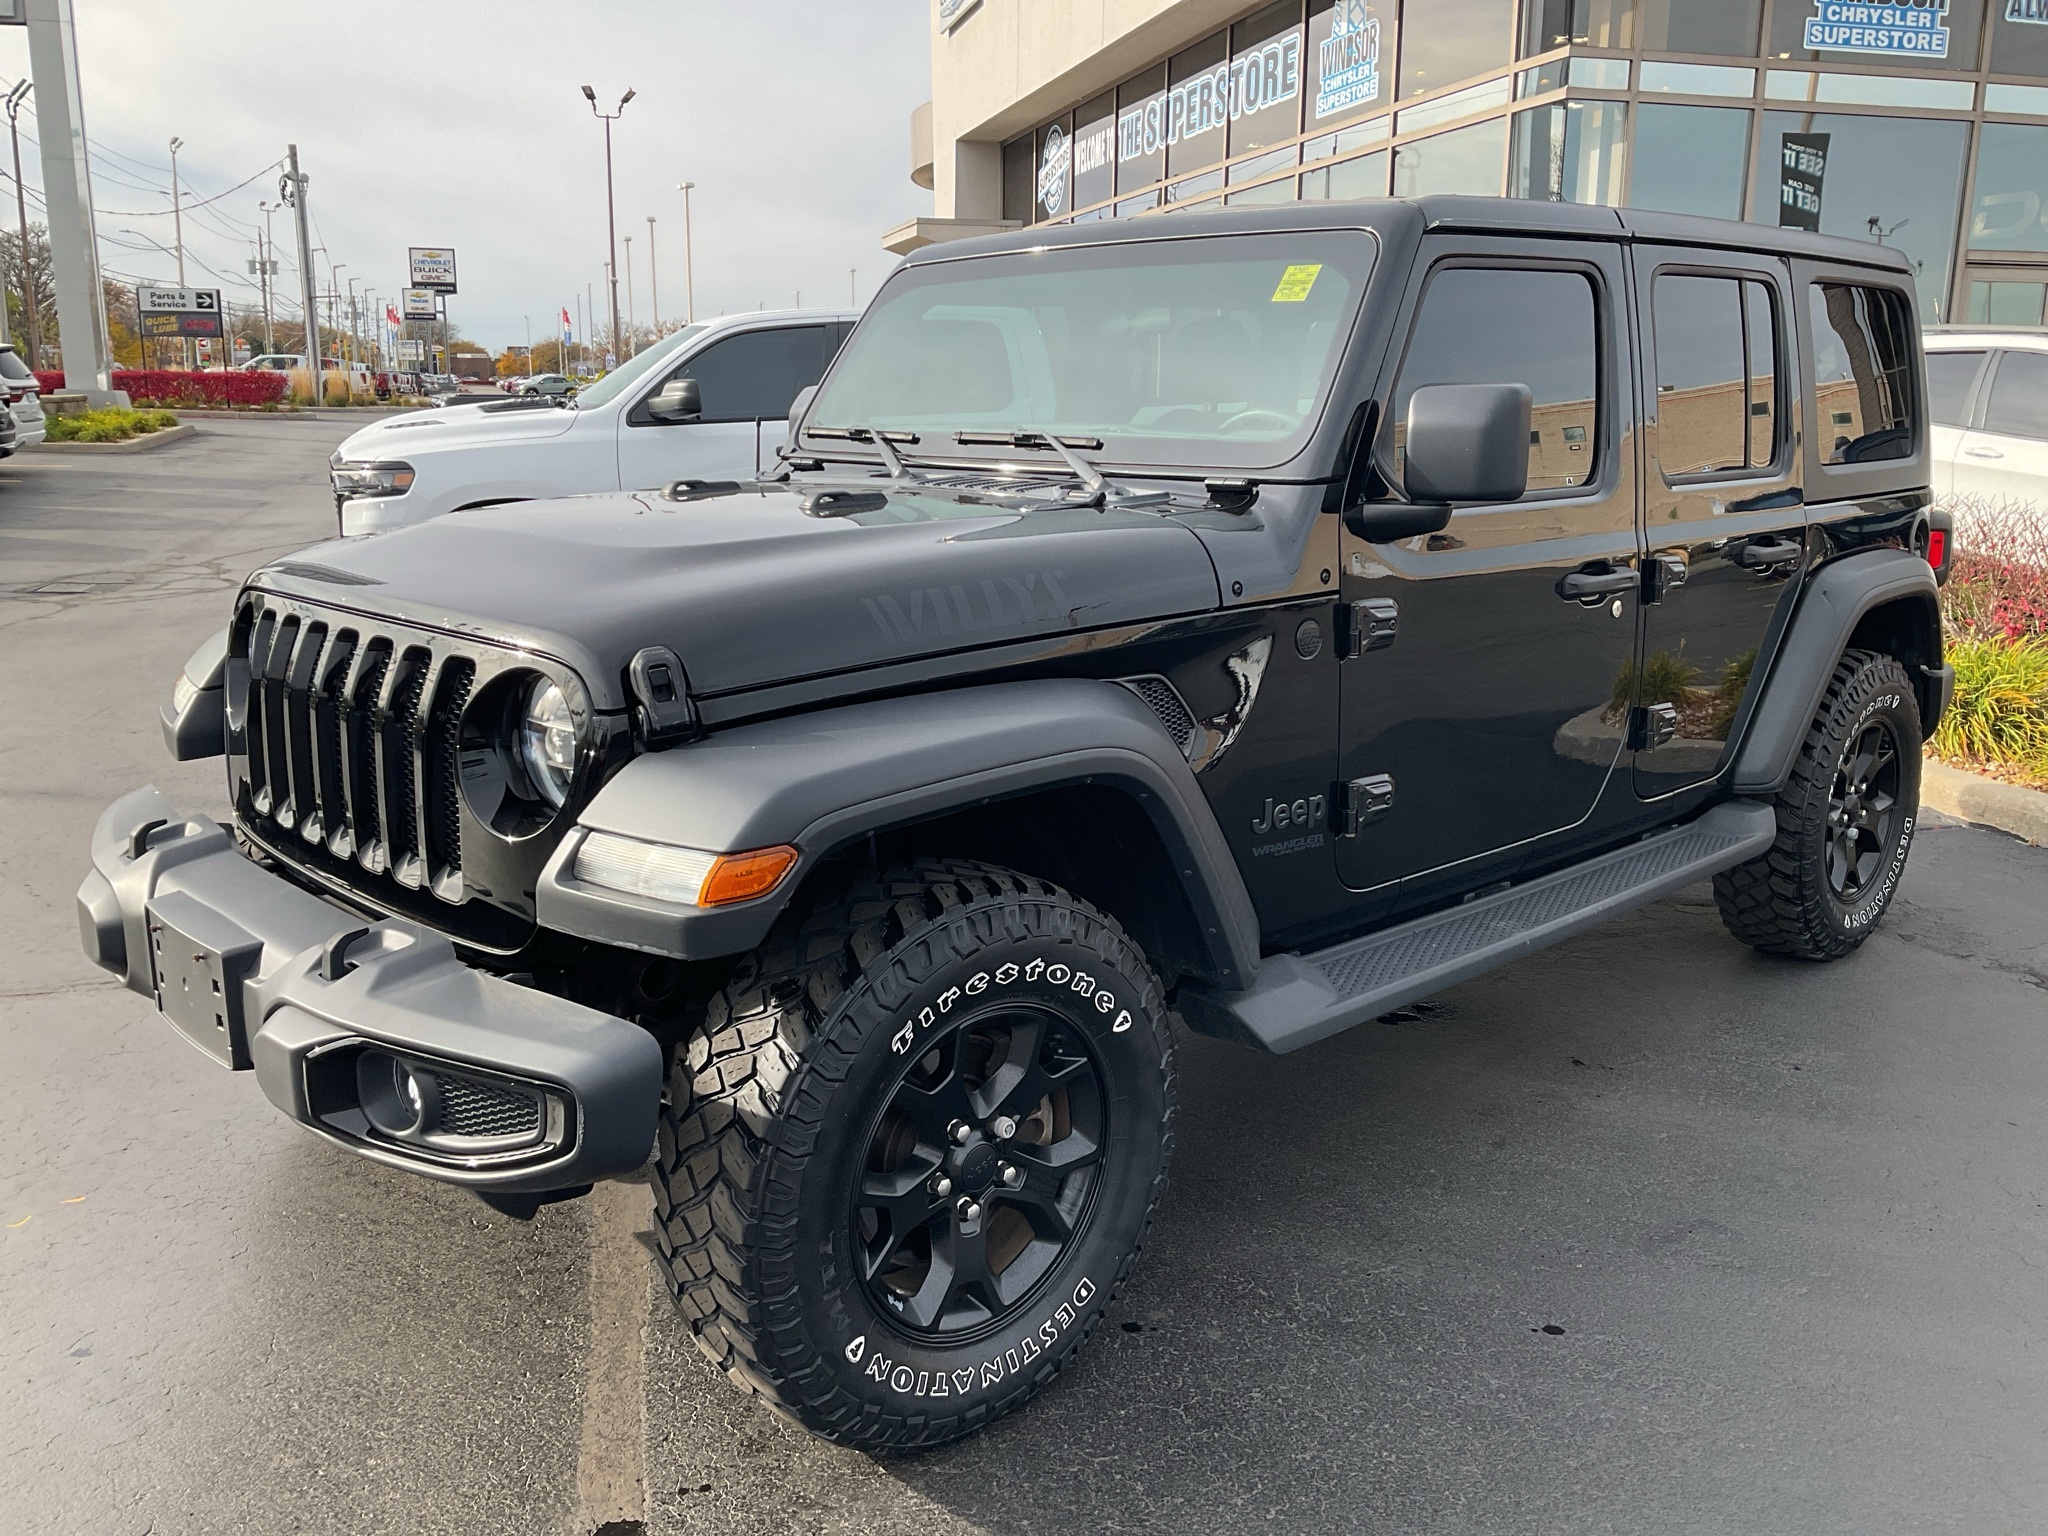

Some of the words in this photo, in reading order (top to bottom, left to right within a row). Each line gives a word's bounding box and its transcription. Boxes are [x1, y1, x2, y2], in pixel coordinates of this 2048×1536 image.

[1826, 4, 1932, 27] CHRYSLER
[1321, 22, 1377, 79] WINDSOR
[1810, 25, 1944, 51] SUPERSTORE
[1324, 64, 1370, 93] CHRYSLER
[1074, 130, 1105, 176] WELCOME
[1106, 126, 1115, 163] TO
[1118, 111, 1143, 161] THE
[1144, 34, 1300, 153] SUPERSTORE
[1317, 79, 1377, 114] SUPERSTORE
[150, 292, 176, 300] Parts
[150, 300, 187, 308] Service
[145, 315, 177, 326] QUICK
[153, 323, 179, 333] LUBE
[1252, 795, 1326, 835] Jeep
[1252, 833, 1324, 857] WRANGLER
[1851, 817, 1912, 928] DESTINATION
[891, 957, 1115, 1055] Firestone
[865, 1276, 1097, 1397] DESTINATION
